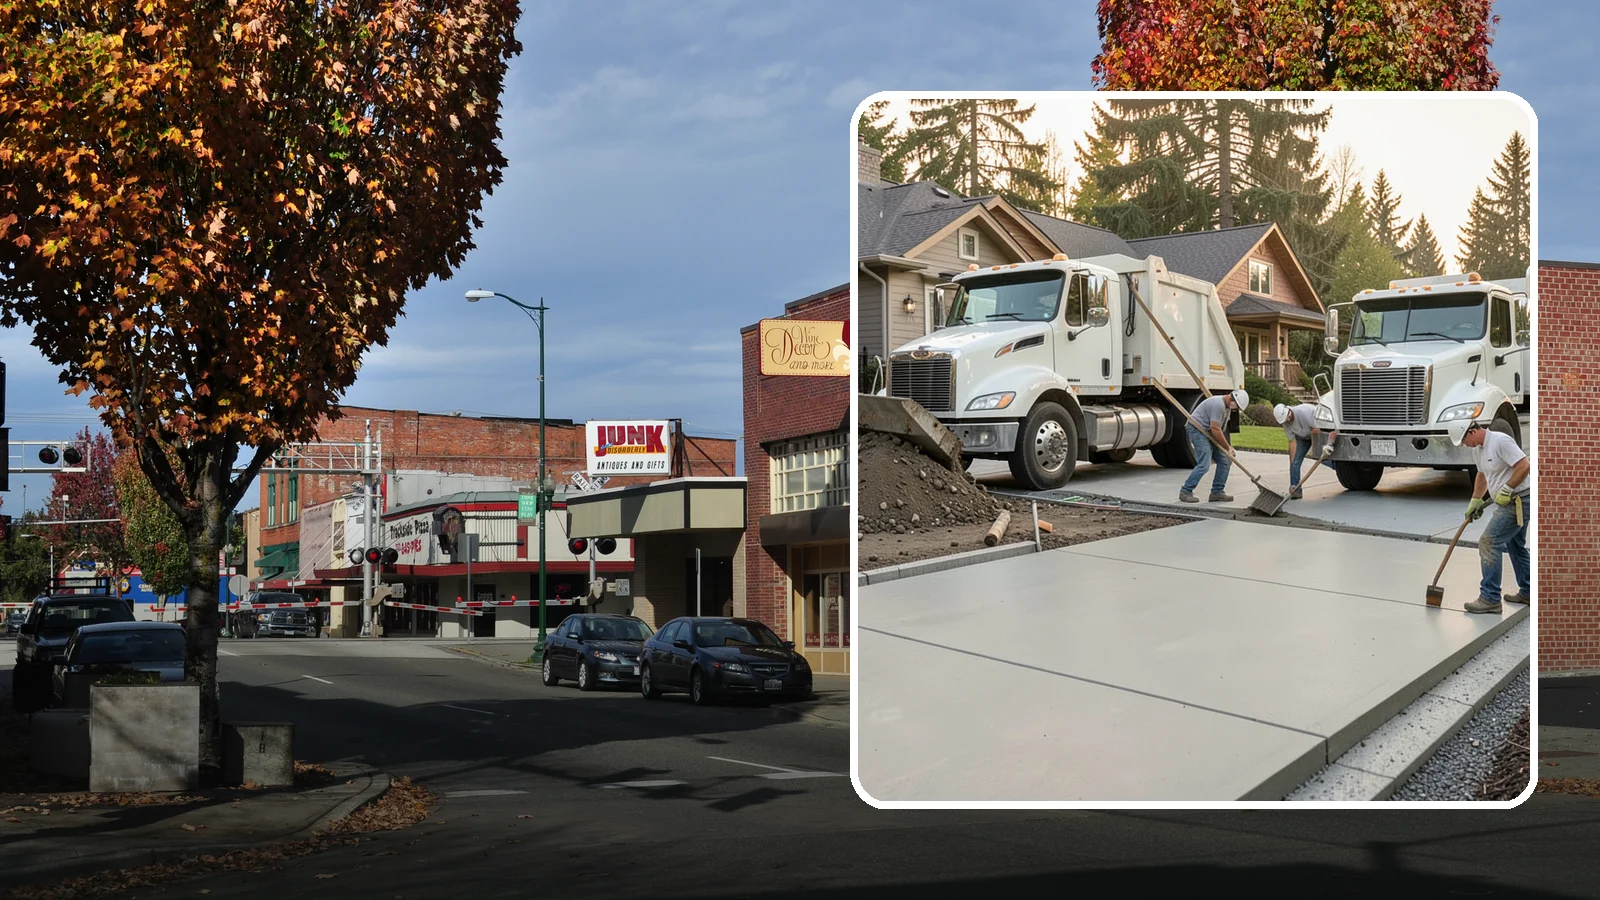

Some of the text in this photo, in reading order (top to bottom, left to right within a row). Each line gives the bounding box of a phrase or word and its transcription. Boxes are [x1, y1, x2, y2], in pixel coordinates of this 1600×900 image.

[595, 425, 665, 457] JUNK
[607, 446, 646, 454] DISORDERLY
[596, 460, 665, 470] ANTIQUES AND GIFTS
